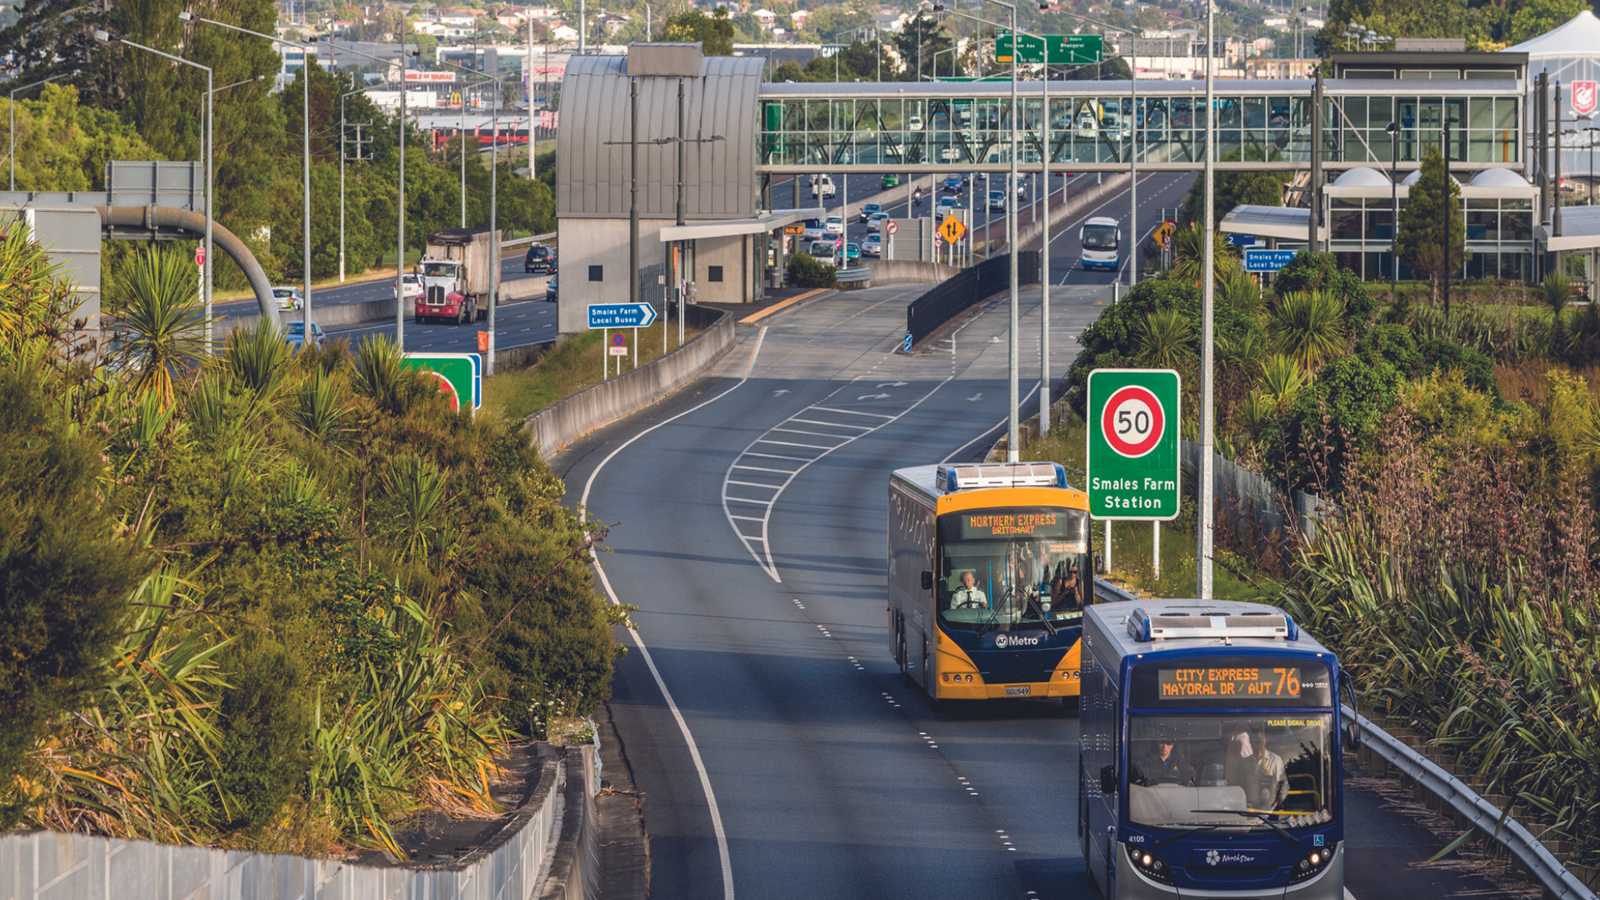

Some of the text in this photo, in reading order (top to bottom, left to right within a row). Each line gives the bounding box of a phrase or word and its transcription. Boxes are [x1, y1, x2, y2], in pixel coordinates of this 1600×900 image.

[1228, 236, 1234, 245] 2
[1118, 410, 1150, 434] 50
[1092, 477, 1175, 490] Smales Farm
[1105, 496, 1161, 508] Station
[970, 514, 1057, 528] NORTHERN EXPRESS
[992, 526, 1035, 535] BRITOMART
[1009, 636, 1038, 646] Metro
[1176, 668, 1258, 681] CITY EXPRESS
[1163, 683, 1216, 695] MAYORAL
[1220, 683, 1235, 695] DR
[1248, 682, 1272, 694] AUT
[1274, 668, 1300, 696] 76
[1222, 854, 1255, 863] NorthStar
